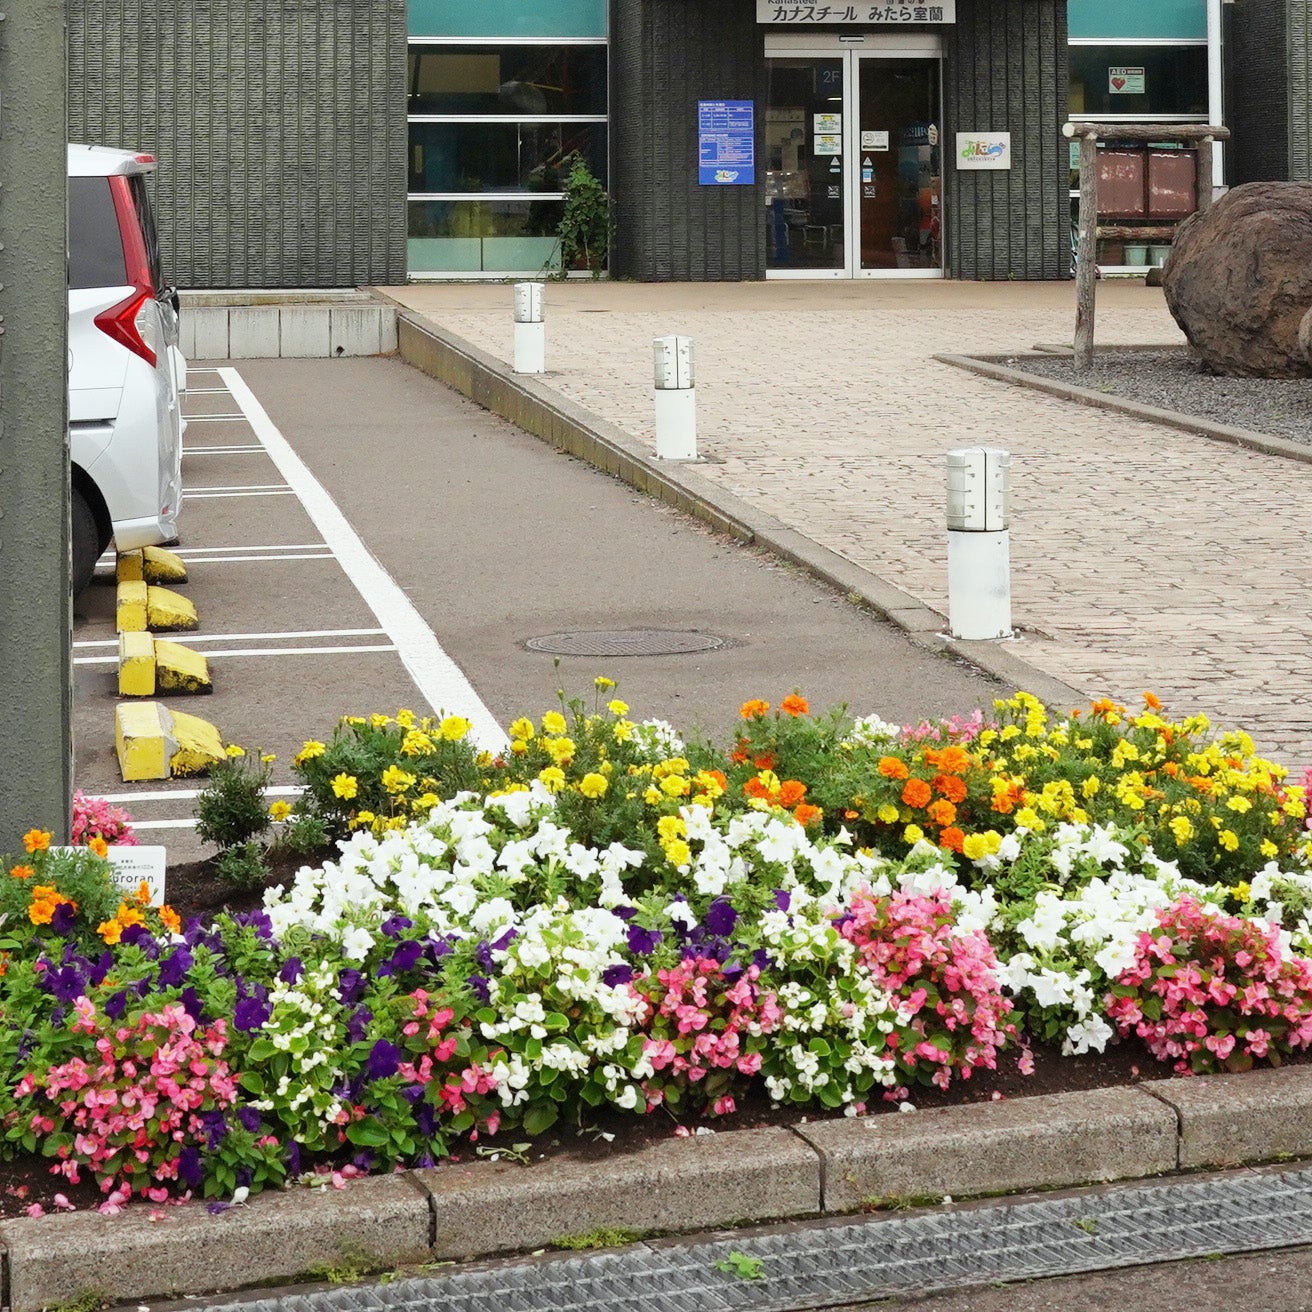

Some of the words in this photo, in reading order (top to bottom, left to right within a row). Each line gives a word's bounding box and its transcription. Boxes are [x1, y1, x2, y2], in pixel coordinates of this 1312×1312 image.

[772, 5, 858, 22] カナスチール
[868, 5, 944, 22] みたら室蘭
[822, 70, 840, 83] 2F
